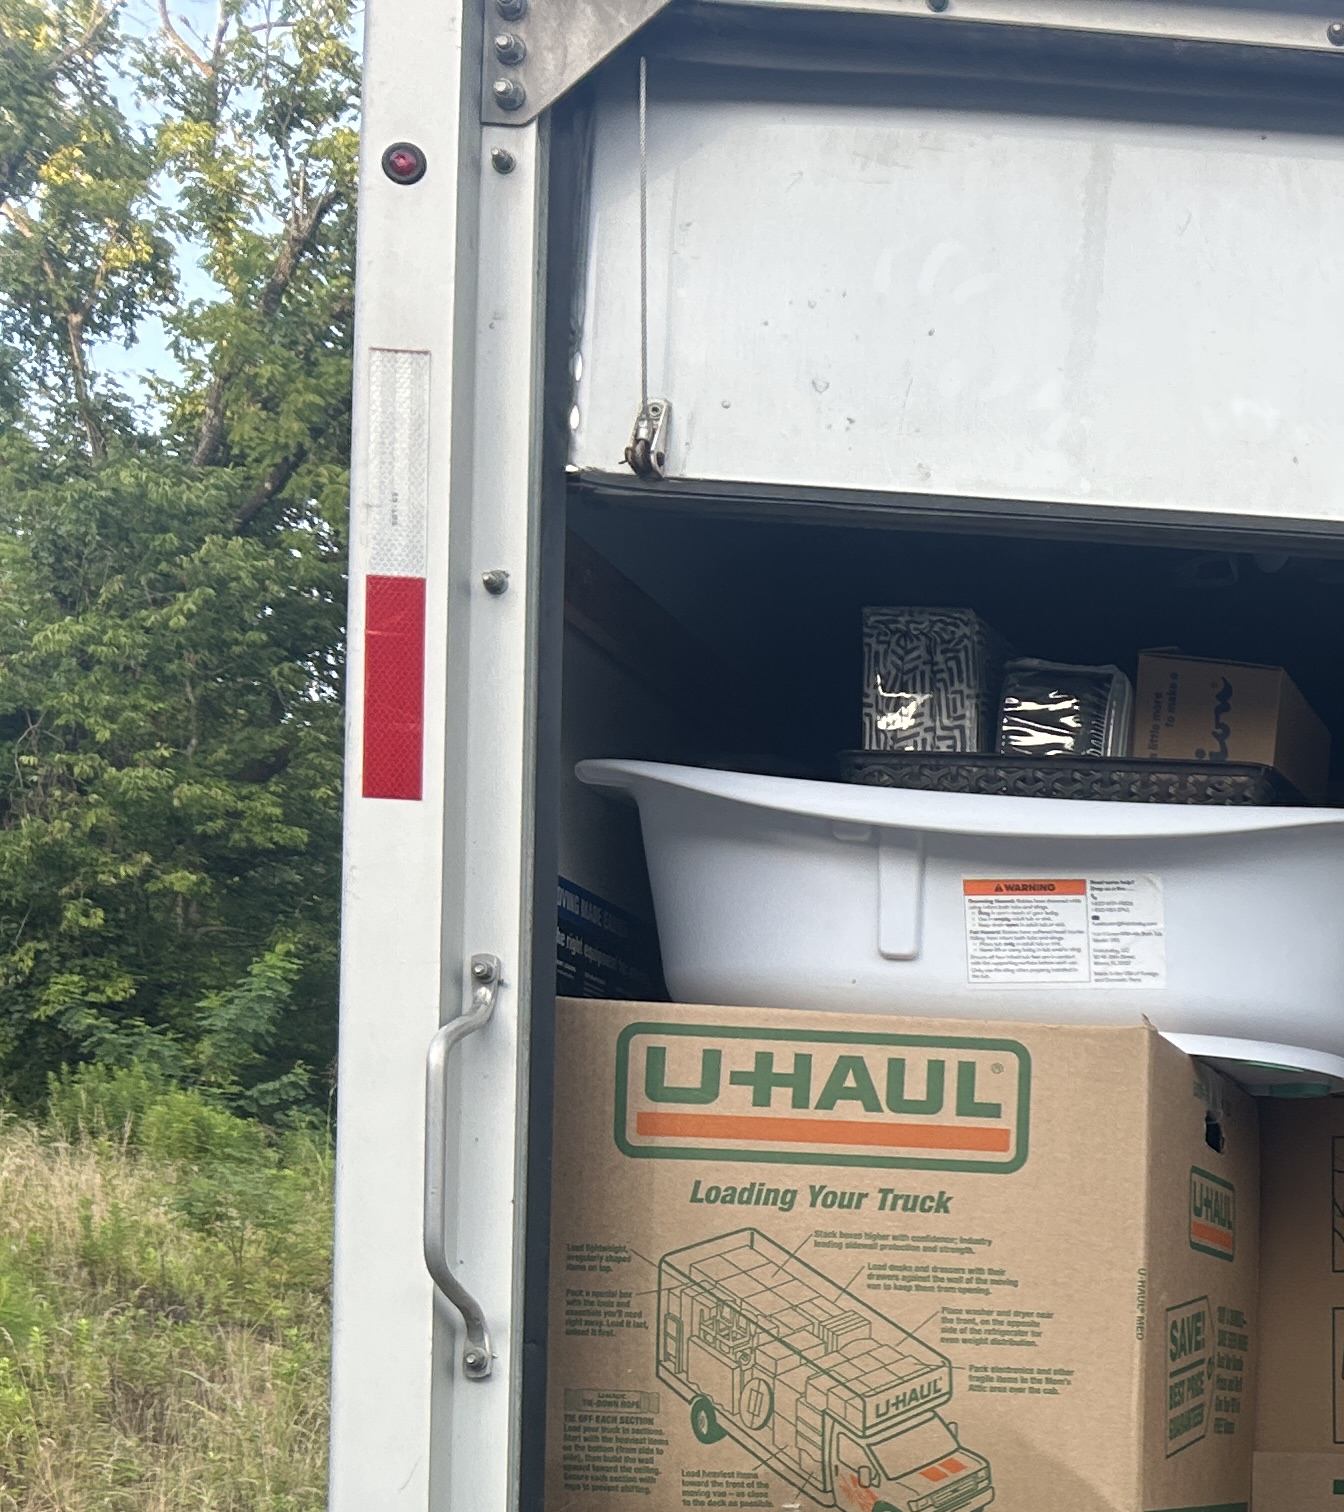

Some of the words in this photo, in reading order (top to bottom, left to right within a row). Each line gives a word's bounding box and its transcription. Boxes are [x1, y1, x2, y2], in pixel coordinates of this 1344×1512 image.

[1004, 883, 1056, 891] WARNING
[645, 1044, 1003, 1120] U-HAUL
[690, 1180, 797, 1212] Loading
[807, 1183, 870, 1213] Your
[877, 1187, 953, 1216] Truck
[1193, 1179, 1233, 1231] U-HAUL
[1170, 1311, 1205, 1362] SAVE!
[874, 1375, 945, 1420] U-HAUL
